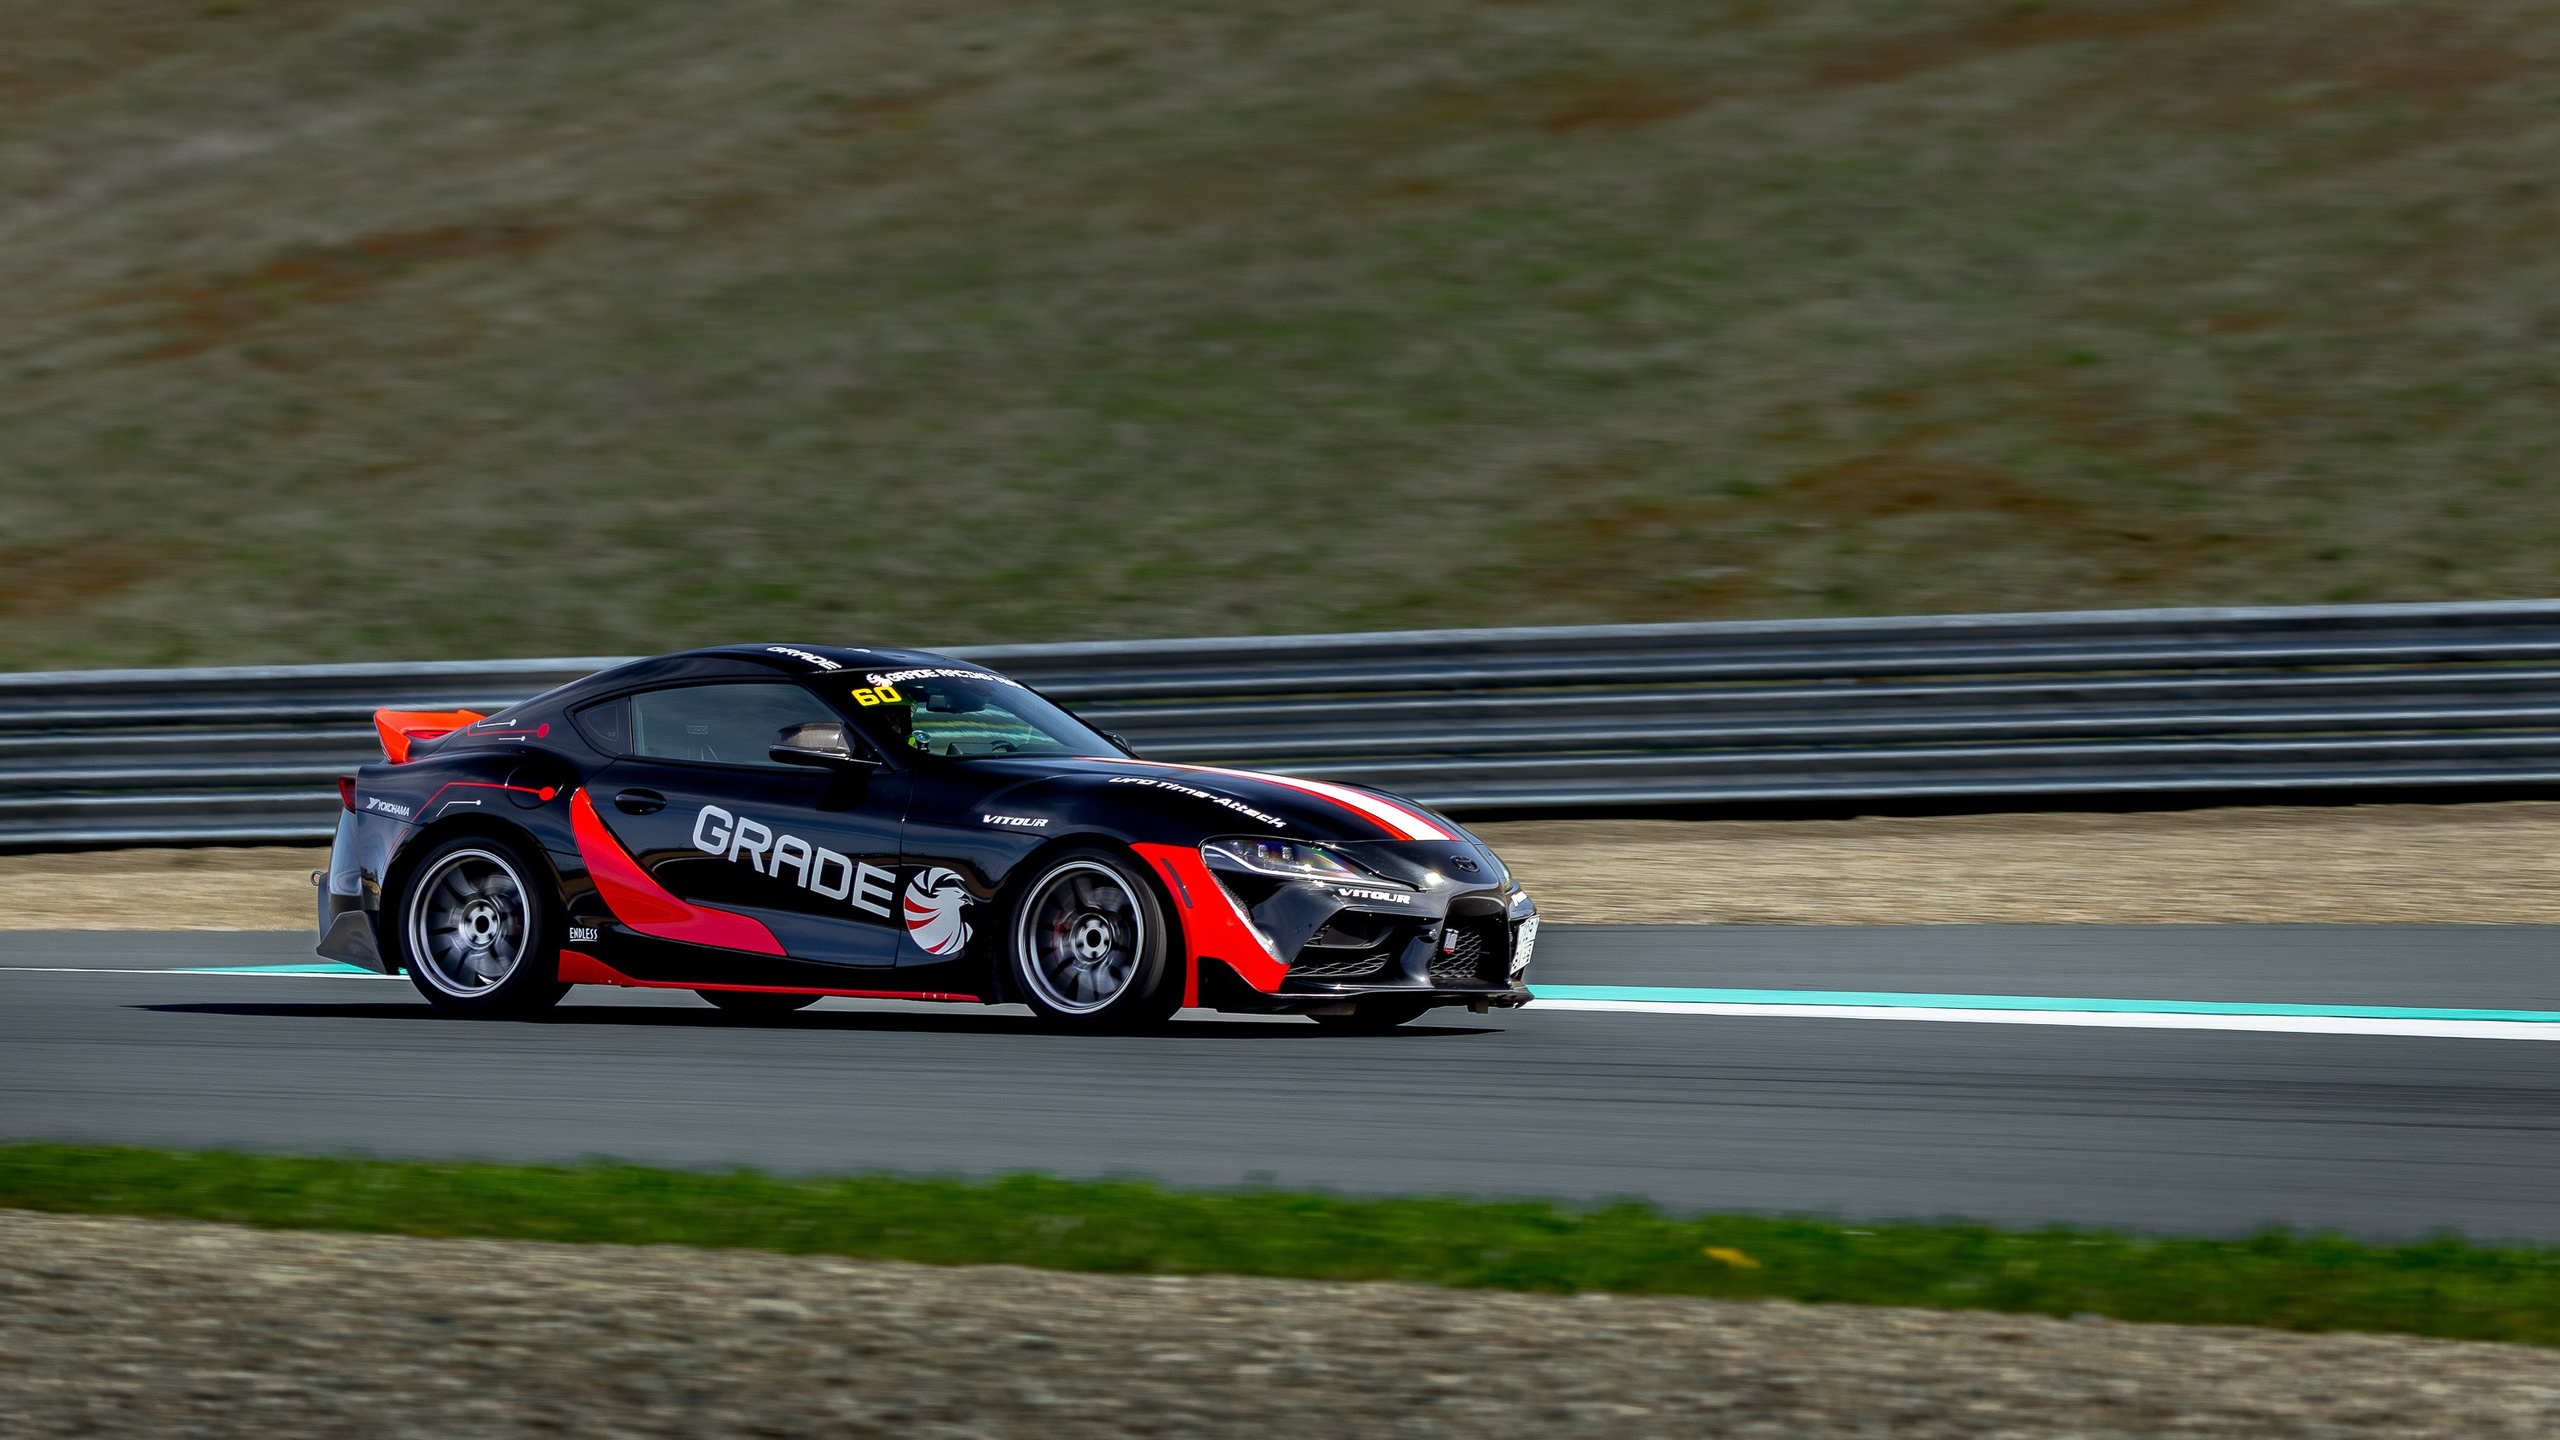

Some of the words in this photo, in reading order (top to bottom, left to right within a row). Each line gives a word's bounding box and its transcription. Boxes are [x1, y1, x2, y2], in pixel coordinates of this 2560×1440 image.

[766, 646, 842, 670] GRADE
[886, 668, 940, 683] GRADE
[851, 686, 902, 706] 60
[377, 800, 410, 817] YOKOHAMA
[982, 814, 1049, 827] VITOUR
[692, 804, 897, 918] GRADE
[1338, 888, 1411, 904] VITOUR
[569, 927, 598, 940] ENDLESS
